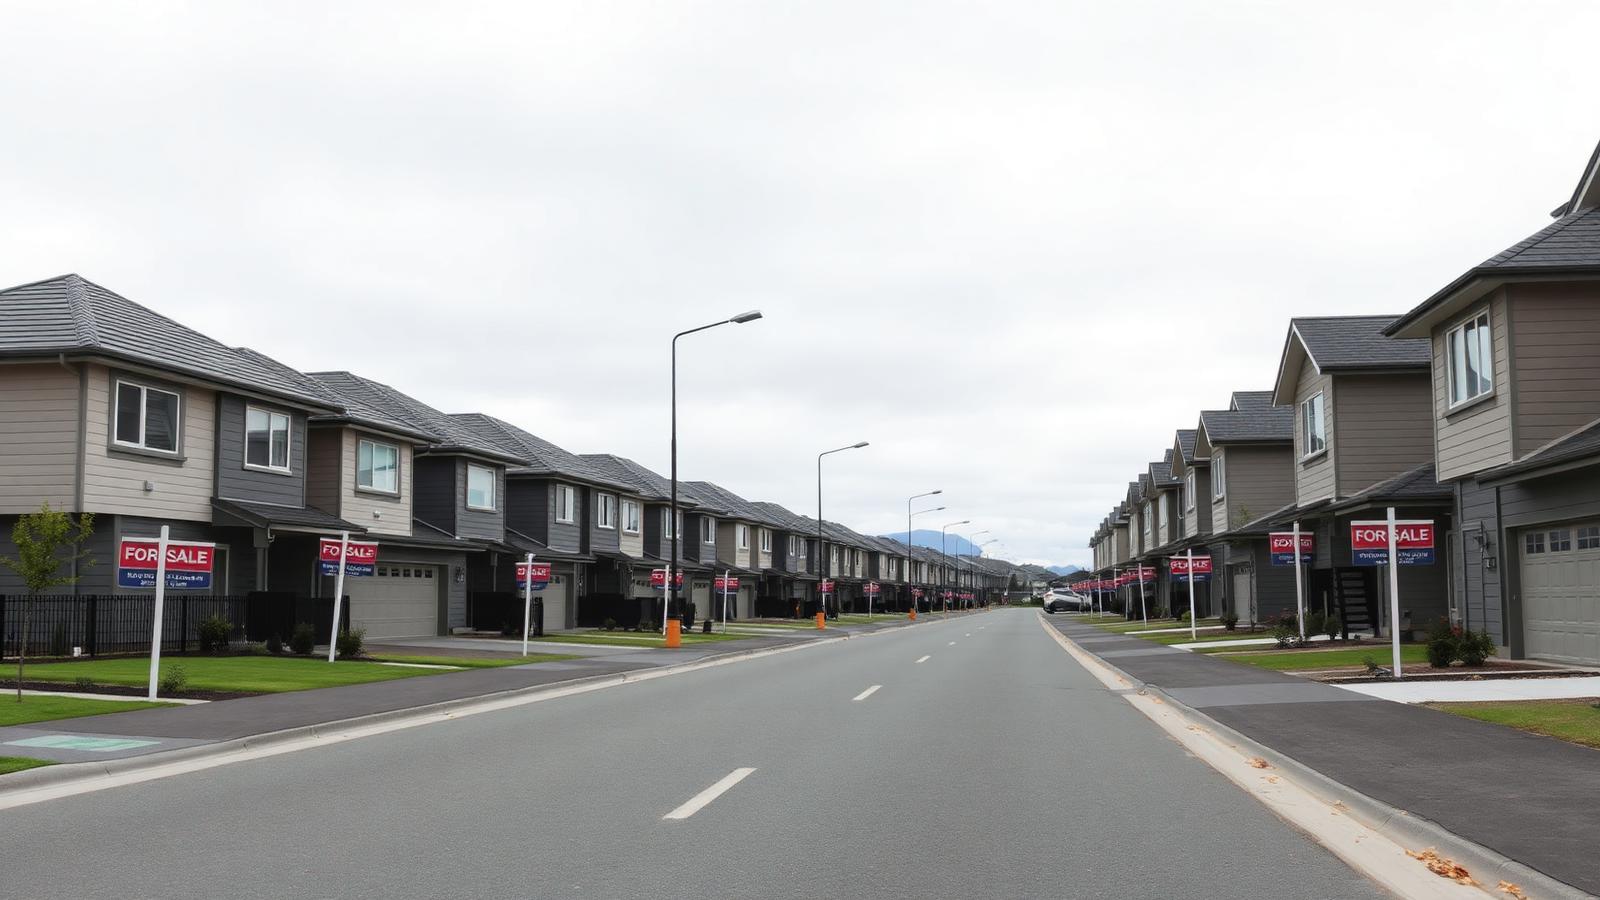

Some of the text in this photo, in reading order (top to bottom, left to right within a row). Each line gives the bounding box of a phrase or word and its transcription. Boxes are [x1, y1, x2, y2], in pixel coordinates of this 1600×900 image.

[1356, 528, 1430, 542] FOR SALE
[125, 546, 209, 564] FOR SALE
[323, 545, 375, 558] FO SALE
